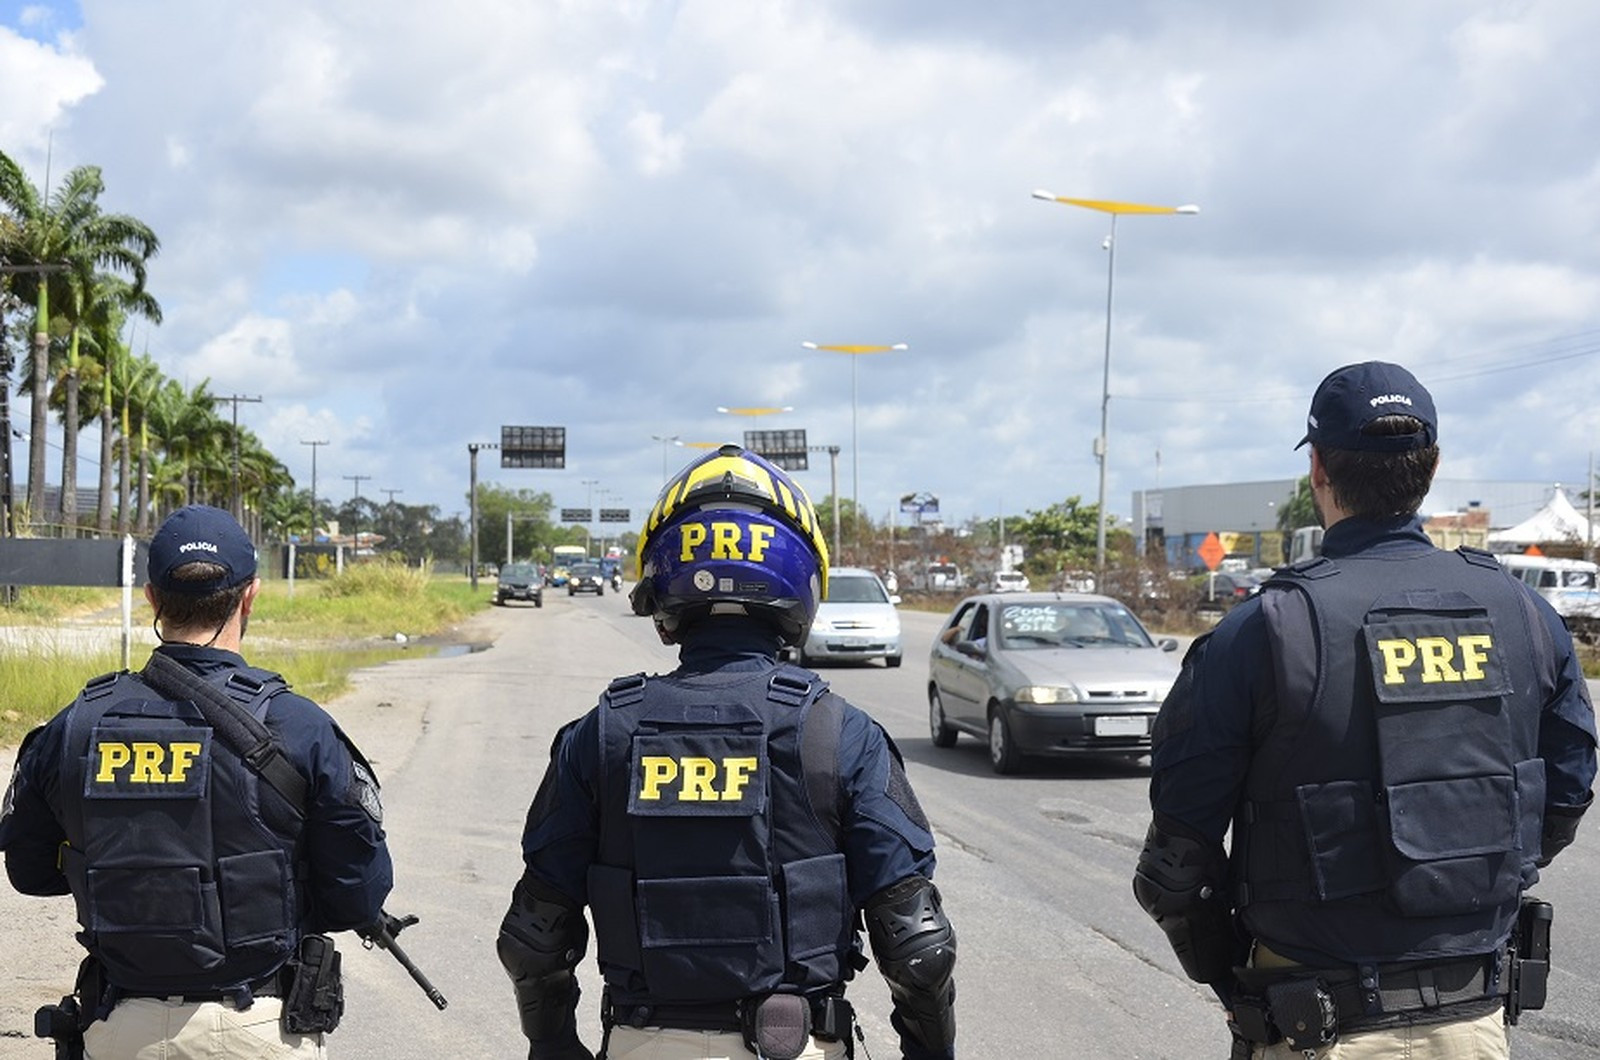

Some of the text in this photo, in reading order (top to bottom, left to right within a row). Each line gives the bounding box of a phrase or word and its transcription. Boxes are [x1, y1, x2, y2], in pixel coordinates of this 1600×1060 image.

[681, 522, 775, 562] PRF
[1378, 634, 1492, 684] PRF
[96, 742, 201, 783] PRF
[640, 756, 758, 801] PRF
